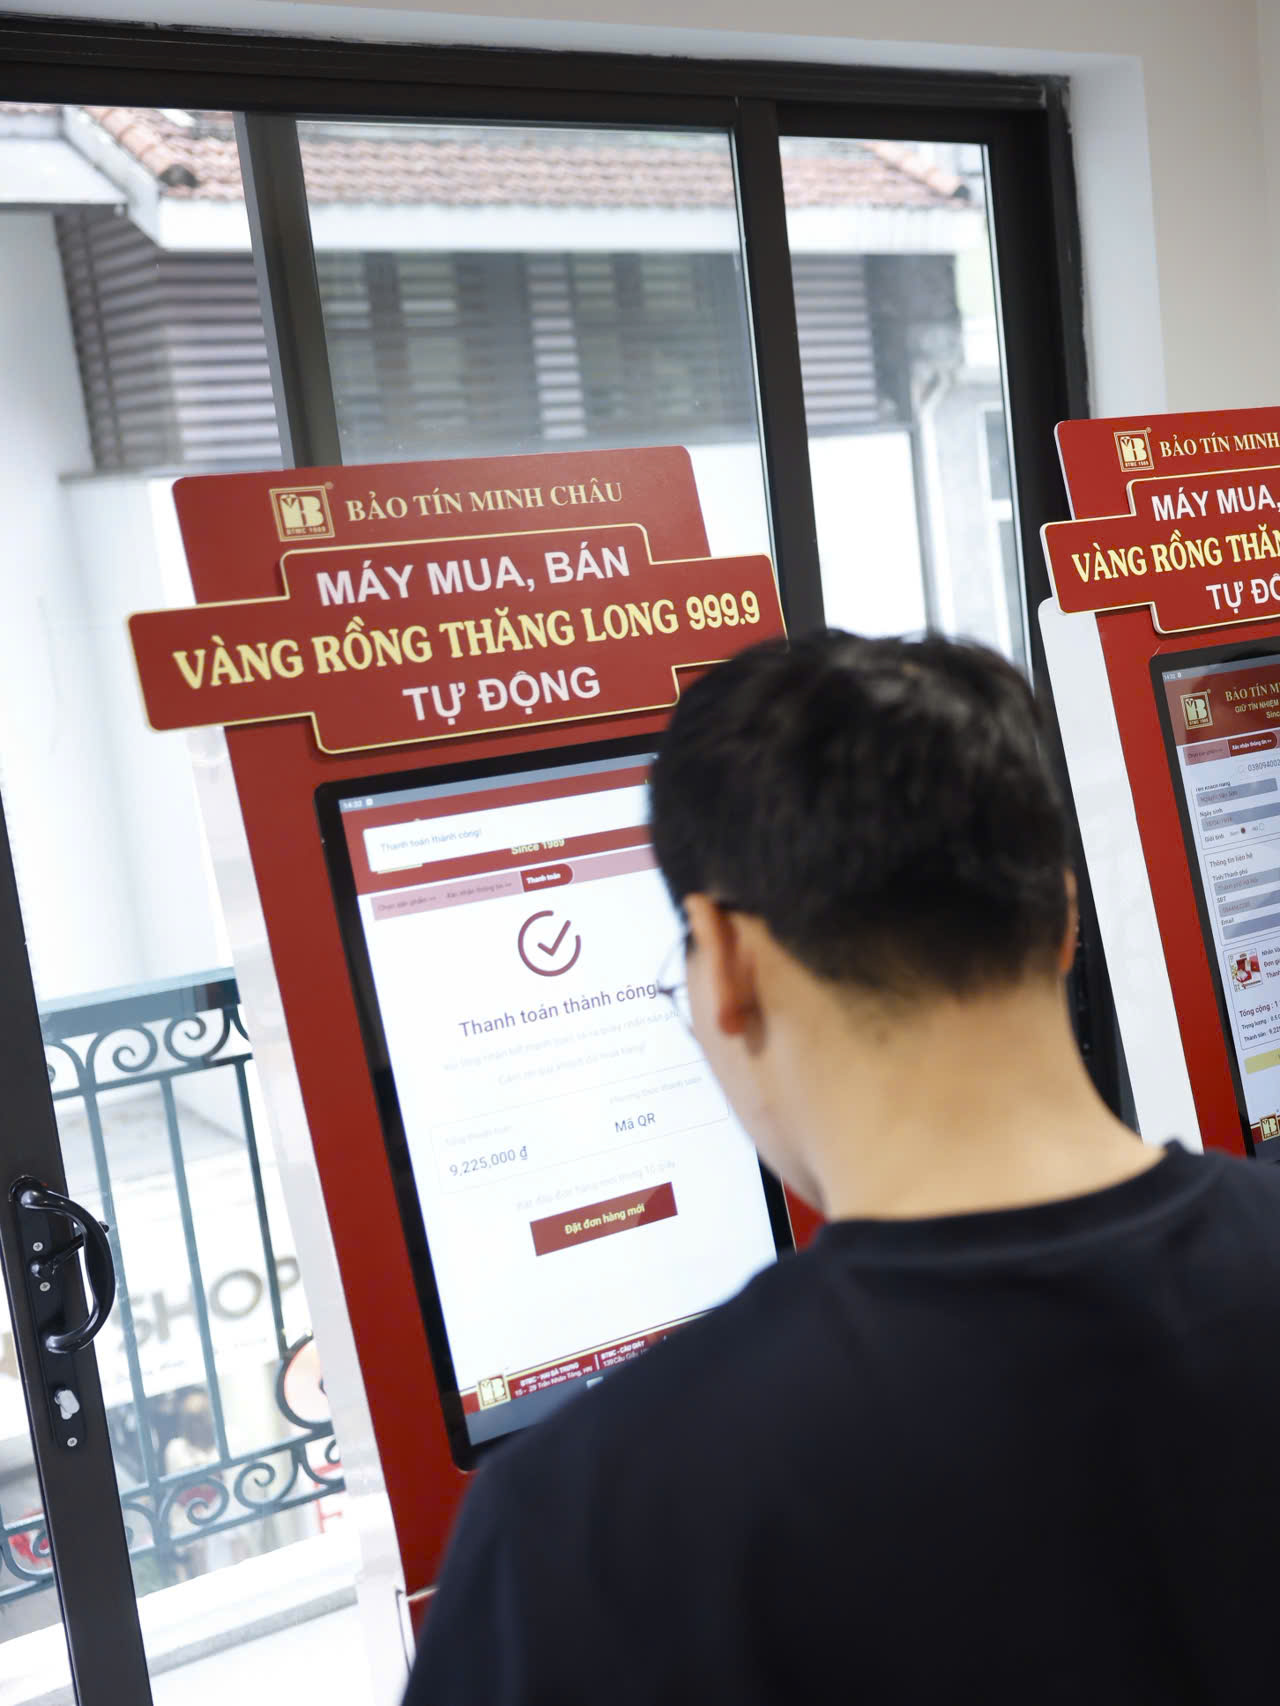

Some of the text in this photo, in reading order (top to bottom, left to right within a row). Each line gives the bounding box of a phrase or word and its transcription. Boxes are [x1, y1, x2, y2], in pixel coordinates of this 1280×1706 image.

[1160, 434, 1197, 459] BẢO
[1200, 431, 1230, 454] TÍN
[1234, 431, 1280, 452] MINH
[346, 476, 623, 523] BẢO TÍN MINH CHÂU
[1151, 485, 1208, 521] MÁY
[1072, 543, 1147, 583] VÀNG
[1152, 528, 1222, 573] RỒNG
[316, 541, 630, 606] MÁY MUA, BÁN
[1206, 580, 1244, 614] TỰ
[173, 589, 761, 690] VÀNG RỒNG THĂNG LONG 999.9
[402, 665, 600, 727] TỰ ĐỘNG
[1248, 702, 1259, 711] TÍN
[1249, 683, 1269, 697] TÍN
[511, 837, 566, 855] Since 1989
[1221, 918, 1234, 926] Email
[459, 1010, 516, 1038] Thanh
[520, 1003, 559, 1026] toán
[563, 990, 612, 1018] thành
[1255, 1003, 1271, 1013] cộng
[615, 1112, 656, 1133] Mã QR
[449, 1149, 517, 1177] 9,225,000
[564, 1203, 645, 1236] Đặt đơn hàng mới
[113, 1256, 300, 1354] SHOP
